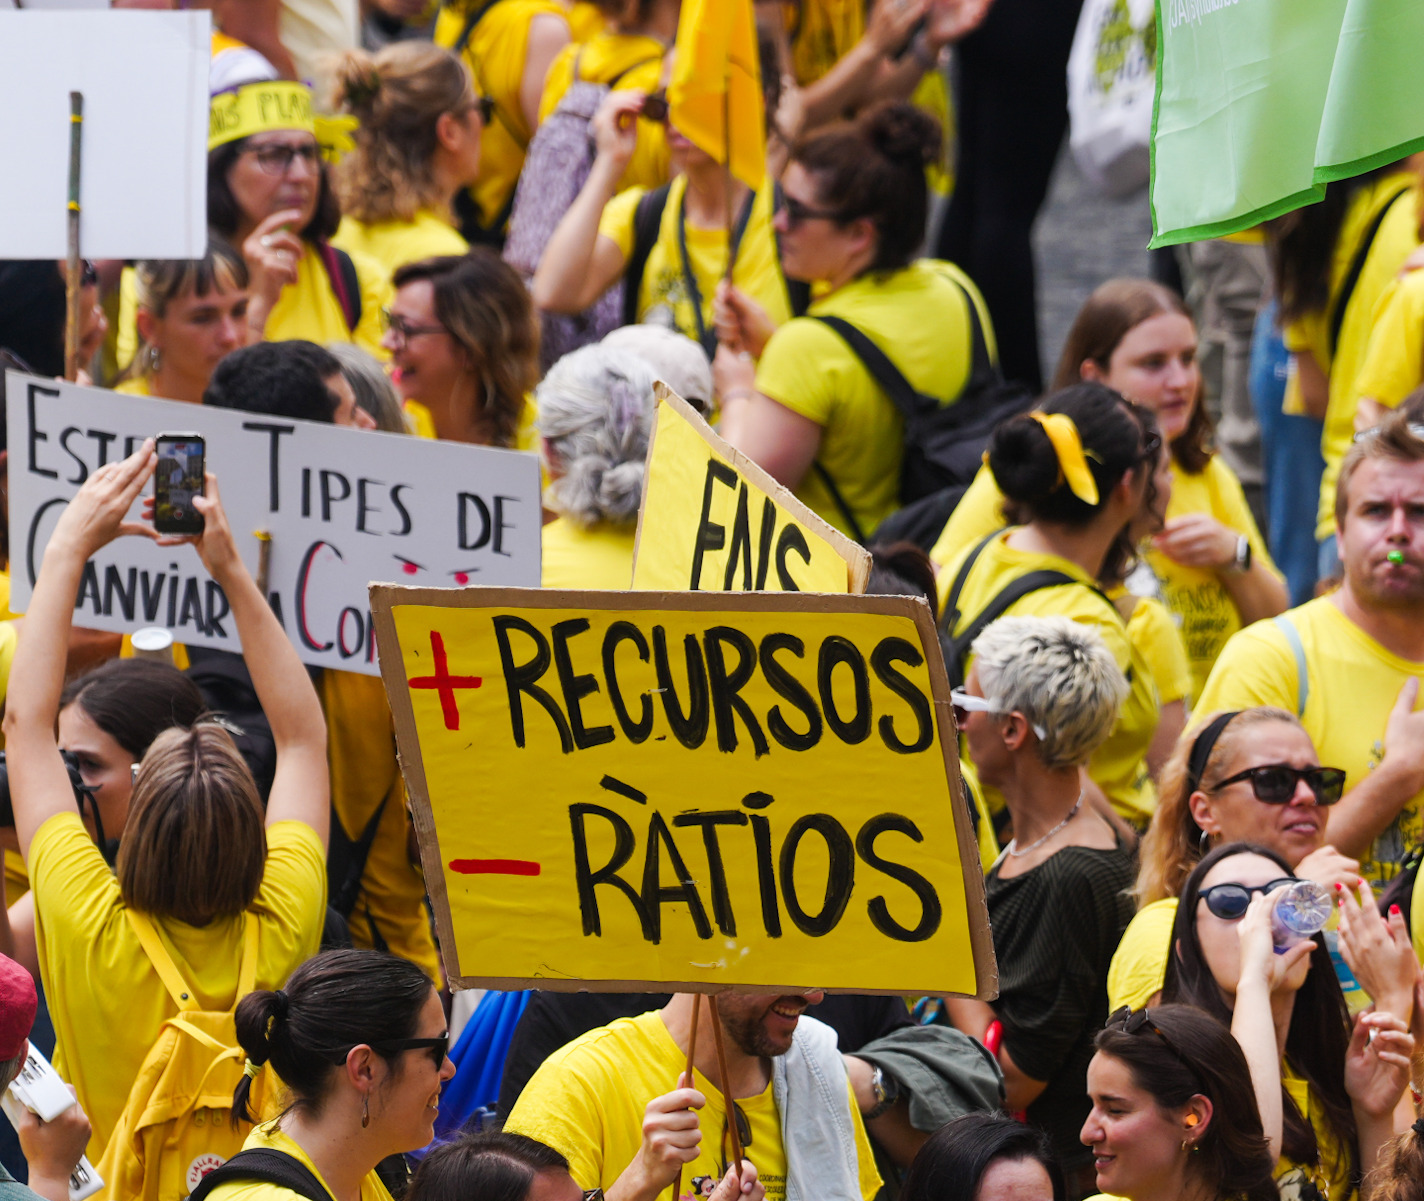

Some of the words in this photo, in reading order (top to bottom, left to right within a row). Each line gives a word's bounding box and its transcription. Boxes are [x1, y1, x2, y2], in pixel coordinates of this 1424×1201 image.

[242, 422, 414, 536] TIPES
[457, 491, 521, 558] DE
[492, 614, 934, 758] RECURSOS
